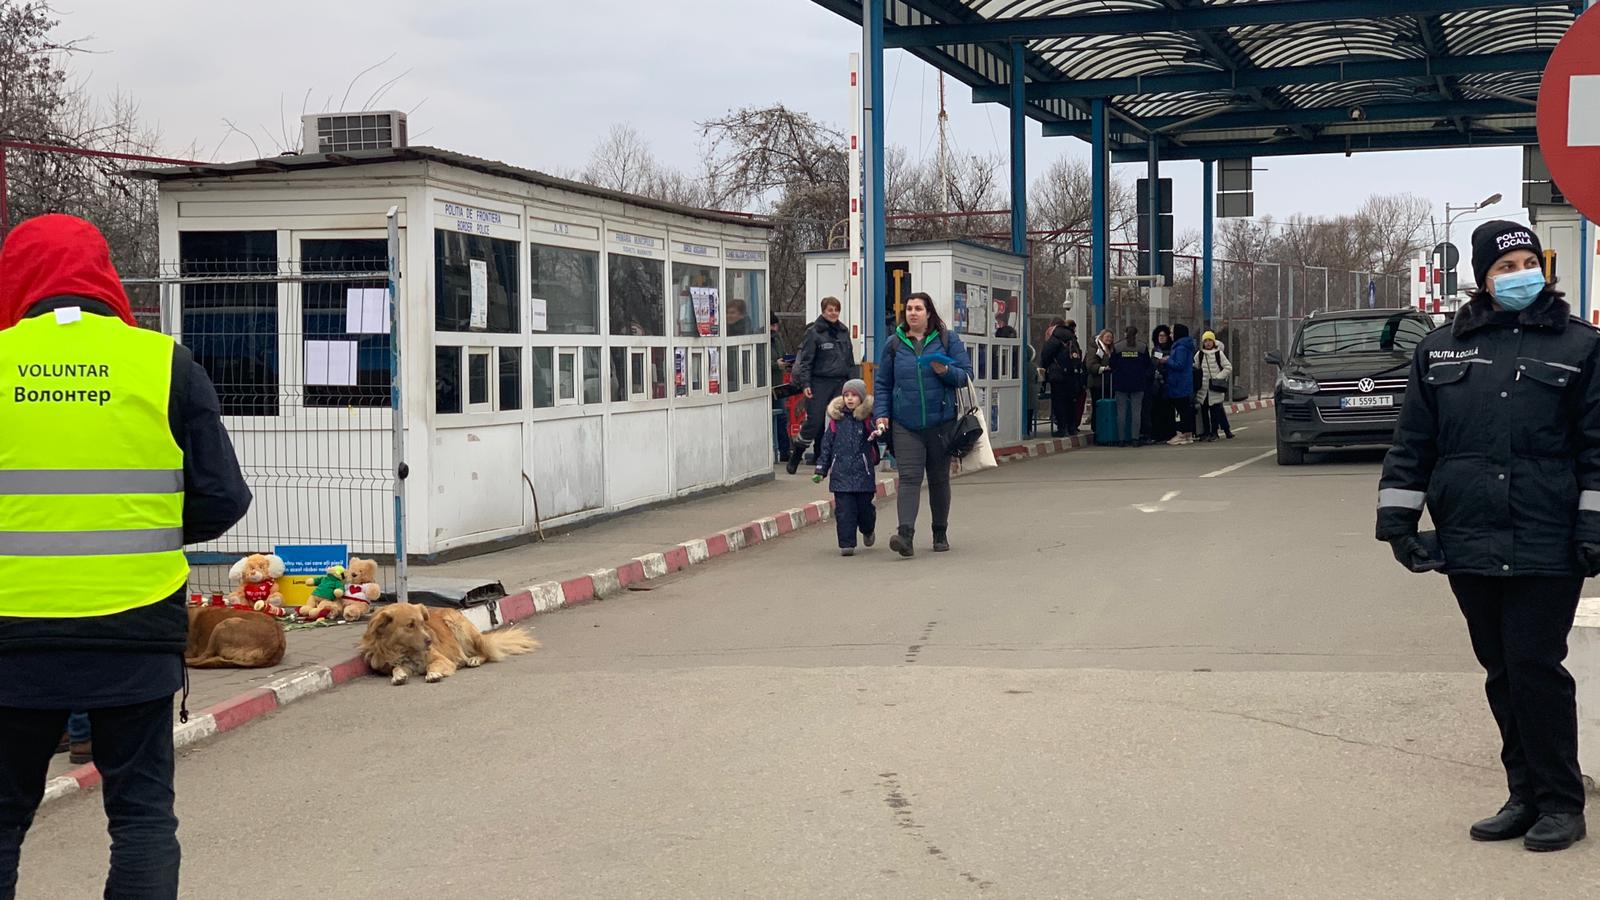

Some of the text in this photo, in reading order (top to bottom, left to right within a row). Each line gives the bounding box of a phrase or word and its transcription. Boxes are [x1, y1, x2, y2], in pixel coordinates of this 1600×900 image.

[466, 207, 473, 219] DE
[457, 220, 490, 235] BORDER POLICE
[18, 364, 109, 378] VOLUNTAR
[14, 386, 111, 406] Волонтер
[1359, 397, 1377, 405] 5595
[1379, 396, 1391, 405] TT
